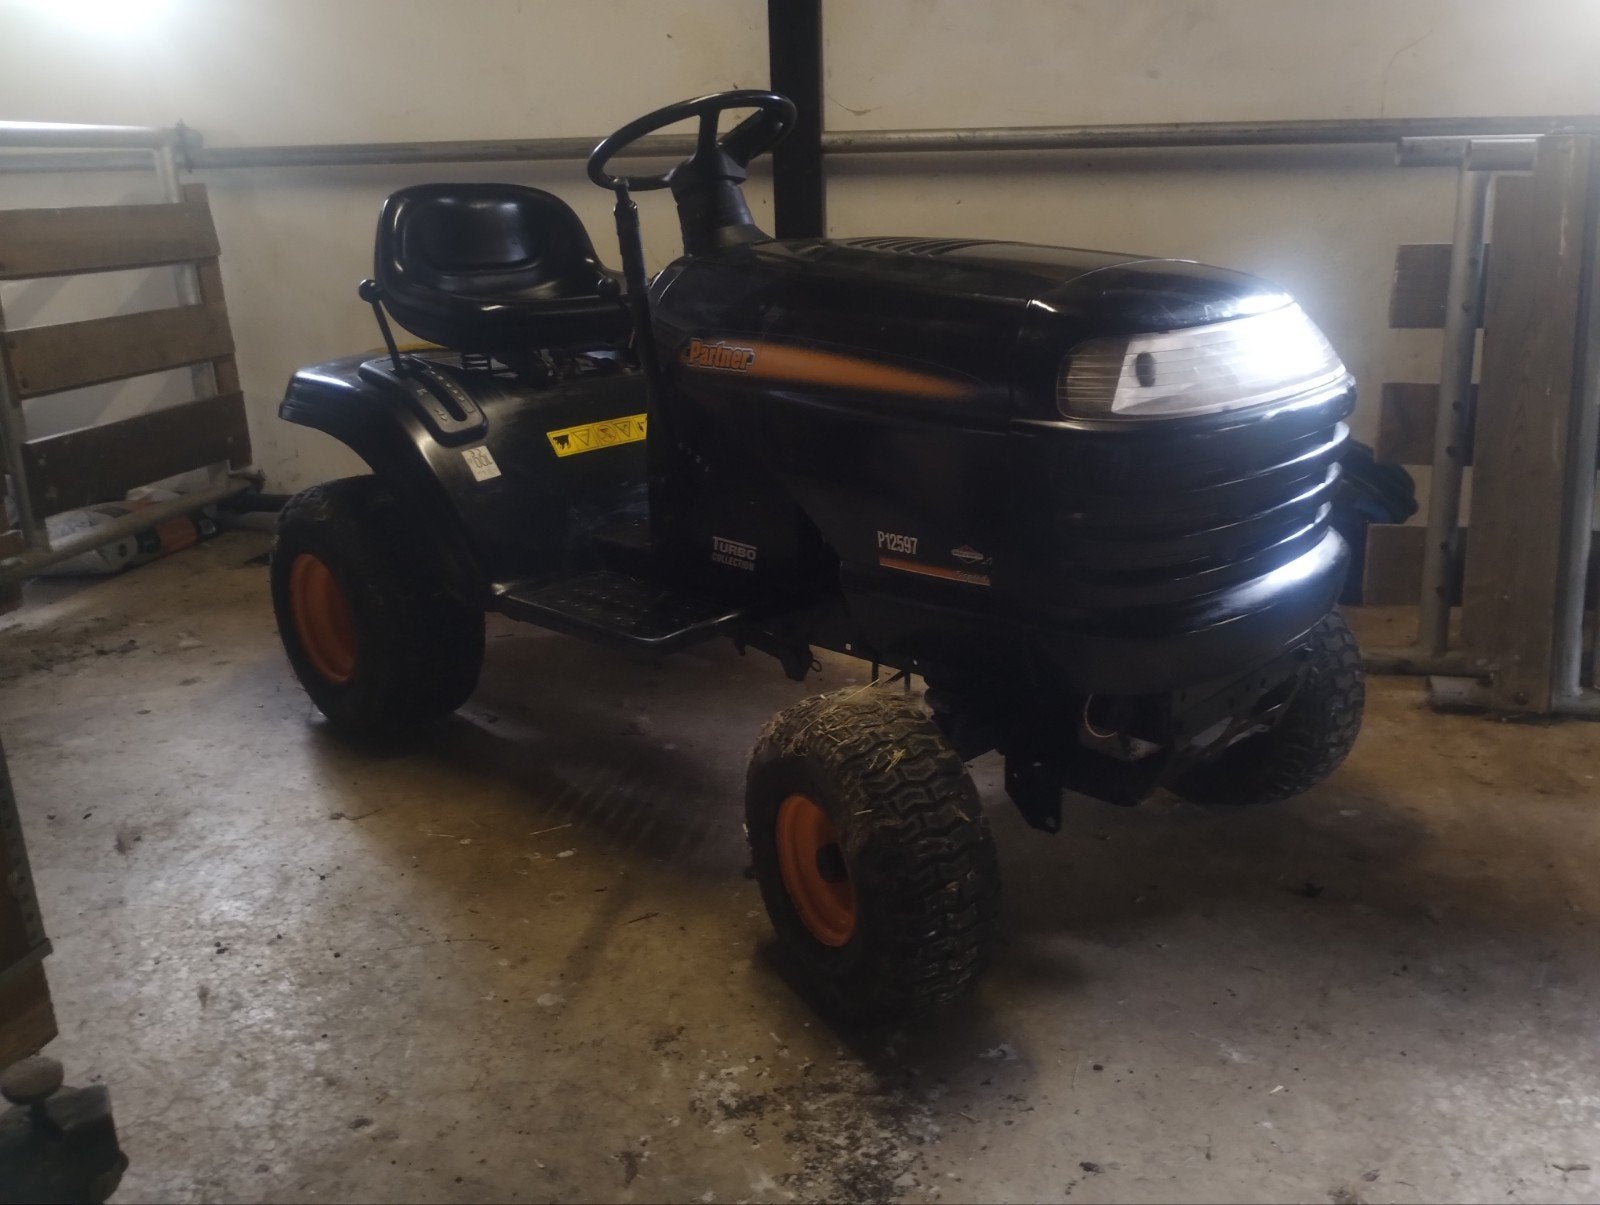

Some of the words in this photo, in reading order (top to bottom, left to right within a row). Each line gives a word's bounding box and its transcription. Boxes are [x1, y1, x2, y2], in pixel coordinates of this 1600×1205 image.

[687, 337, 754, 372] Partner
[712, 536, 757, 561] TURBO
[877, 530, 919, 554] P12597
